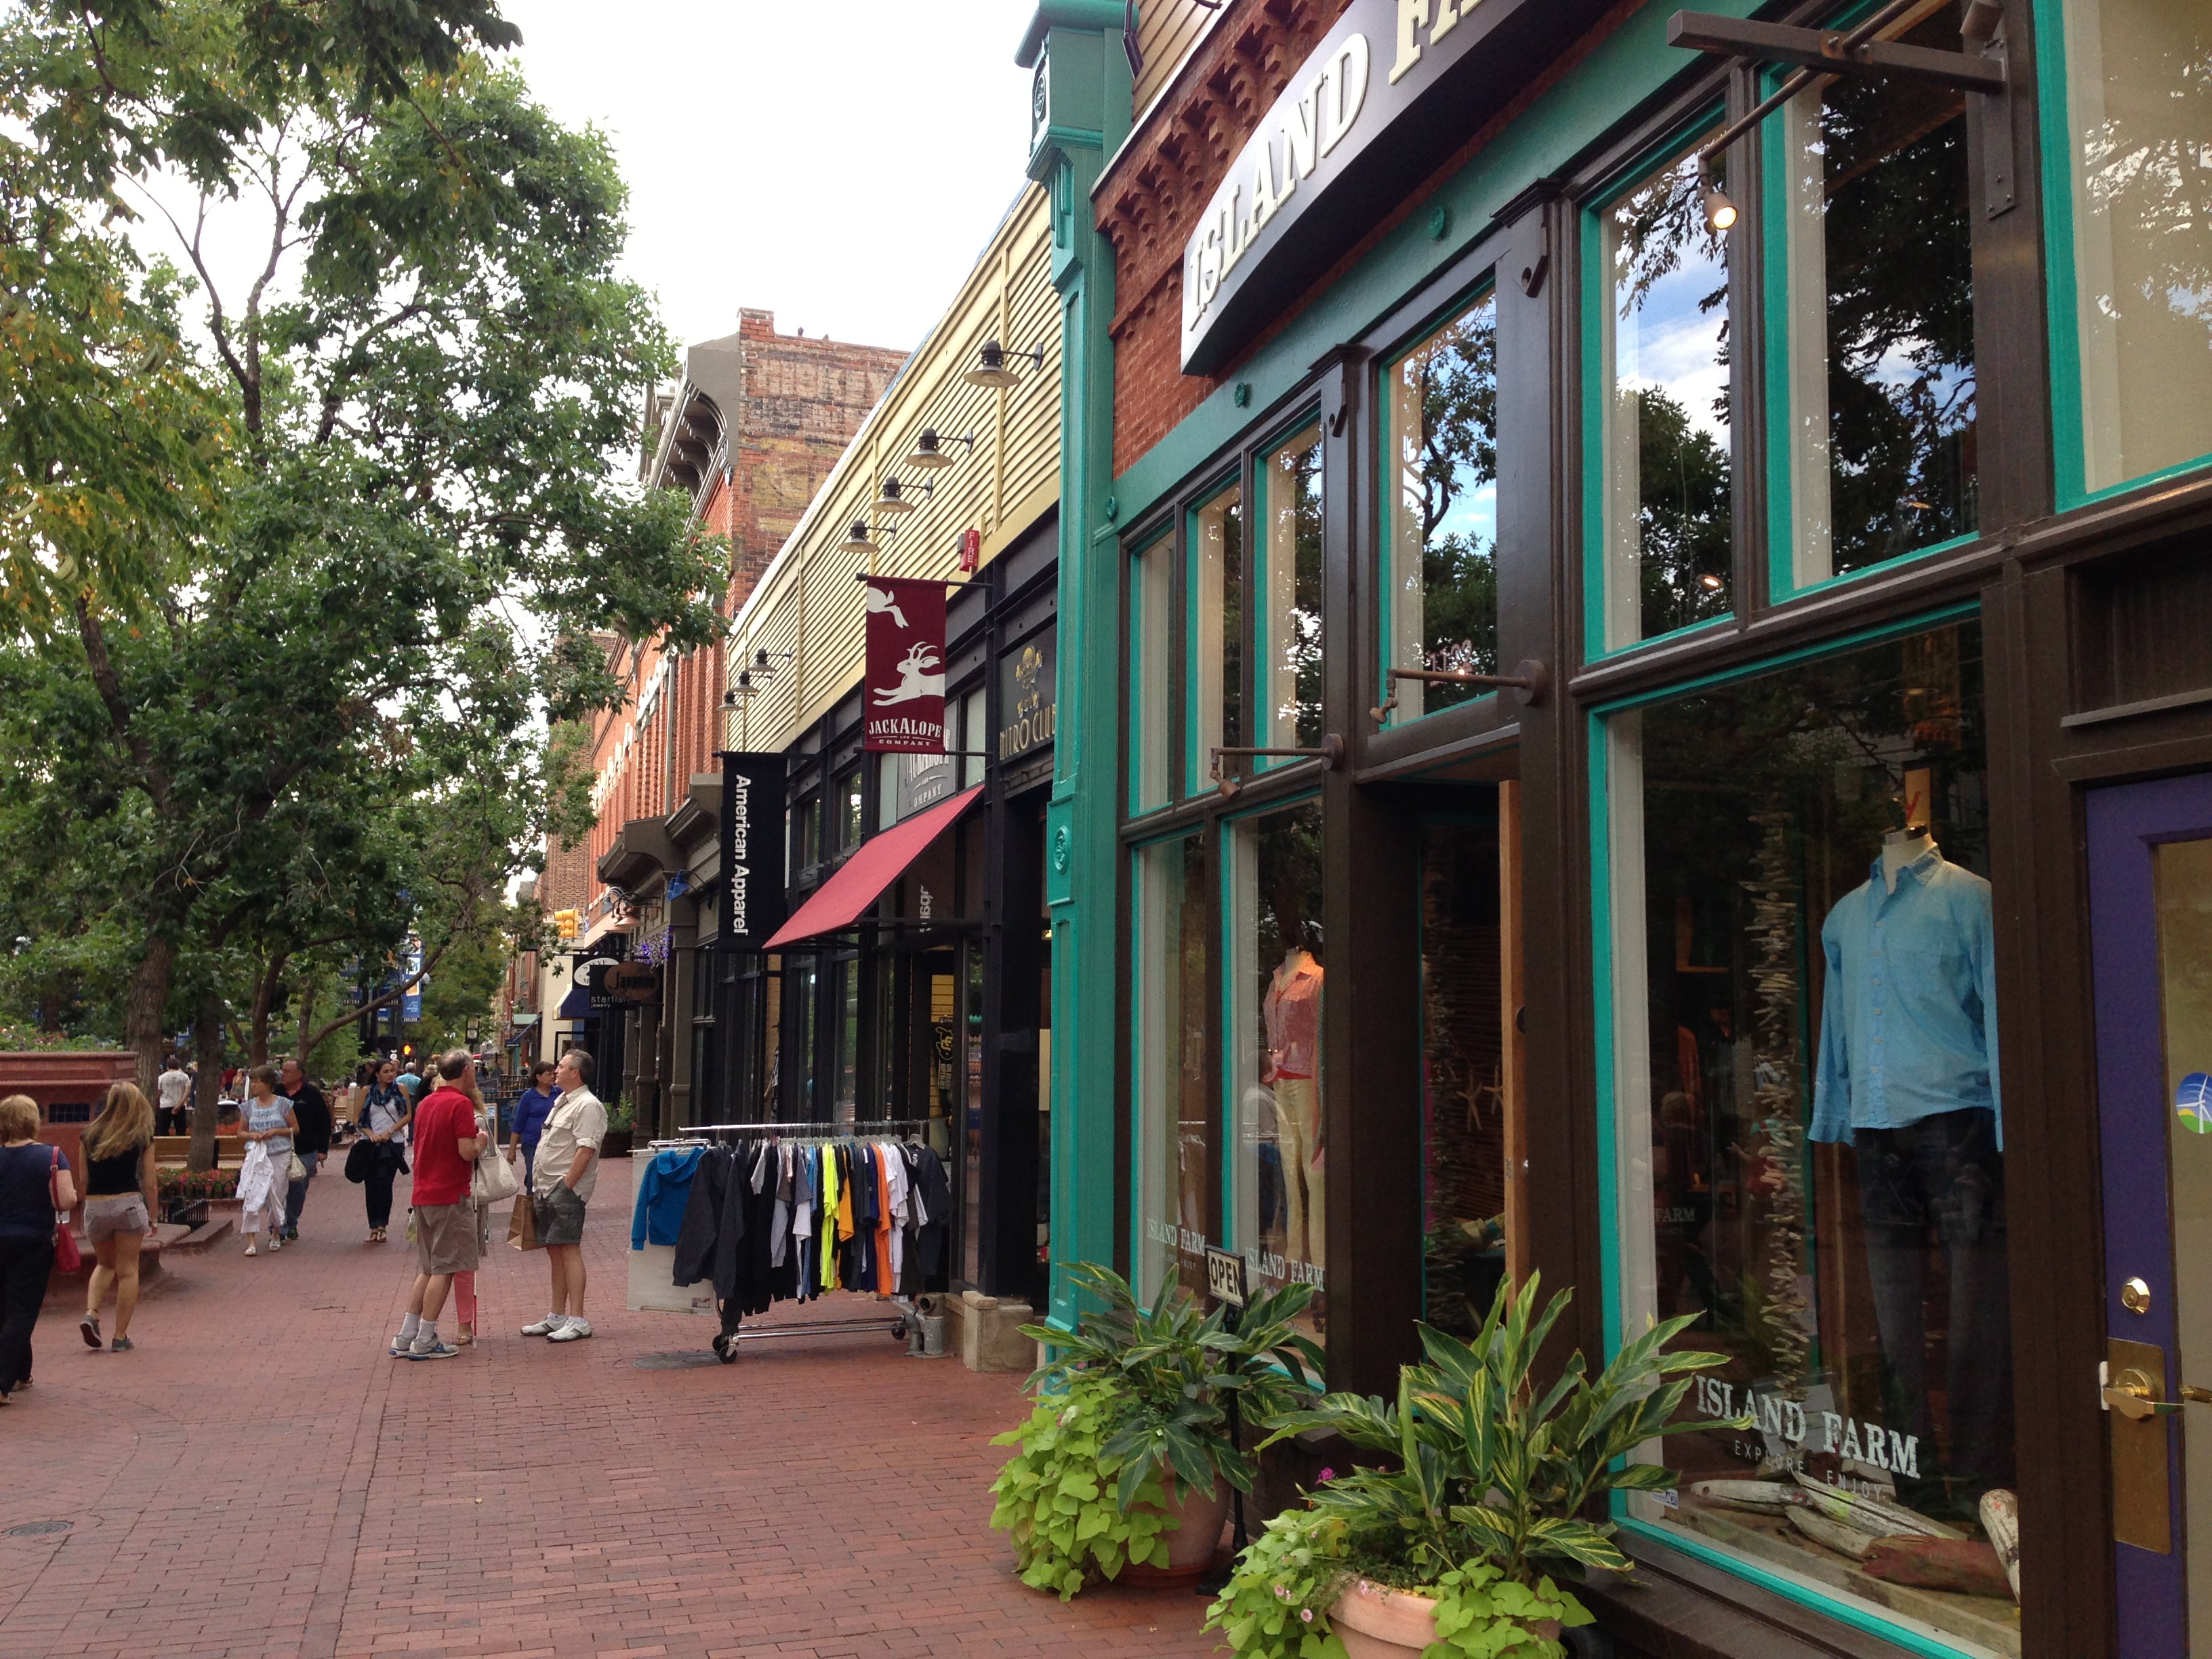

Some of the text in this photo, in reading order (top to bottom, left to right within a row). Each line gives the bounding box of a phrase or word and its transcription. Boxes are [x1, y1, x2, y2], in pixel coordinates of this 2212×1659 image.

[1190, 33, 1369, 331] ISLAND
[869, 717, 942, 738] JACKALOPE
[731, 774, 752, 934] American Apparel
[1147, 1218, 1177, 1247] ISLAND
[1181, 1229, 1206, 1256] FARM
[1210, 1256, 1241, 1296] OPEN
[1244, 1247, 1326, 1292] ISLAND FARM
[1696, 1374, 1921, 1479] ISLAND FARM
